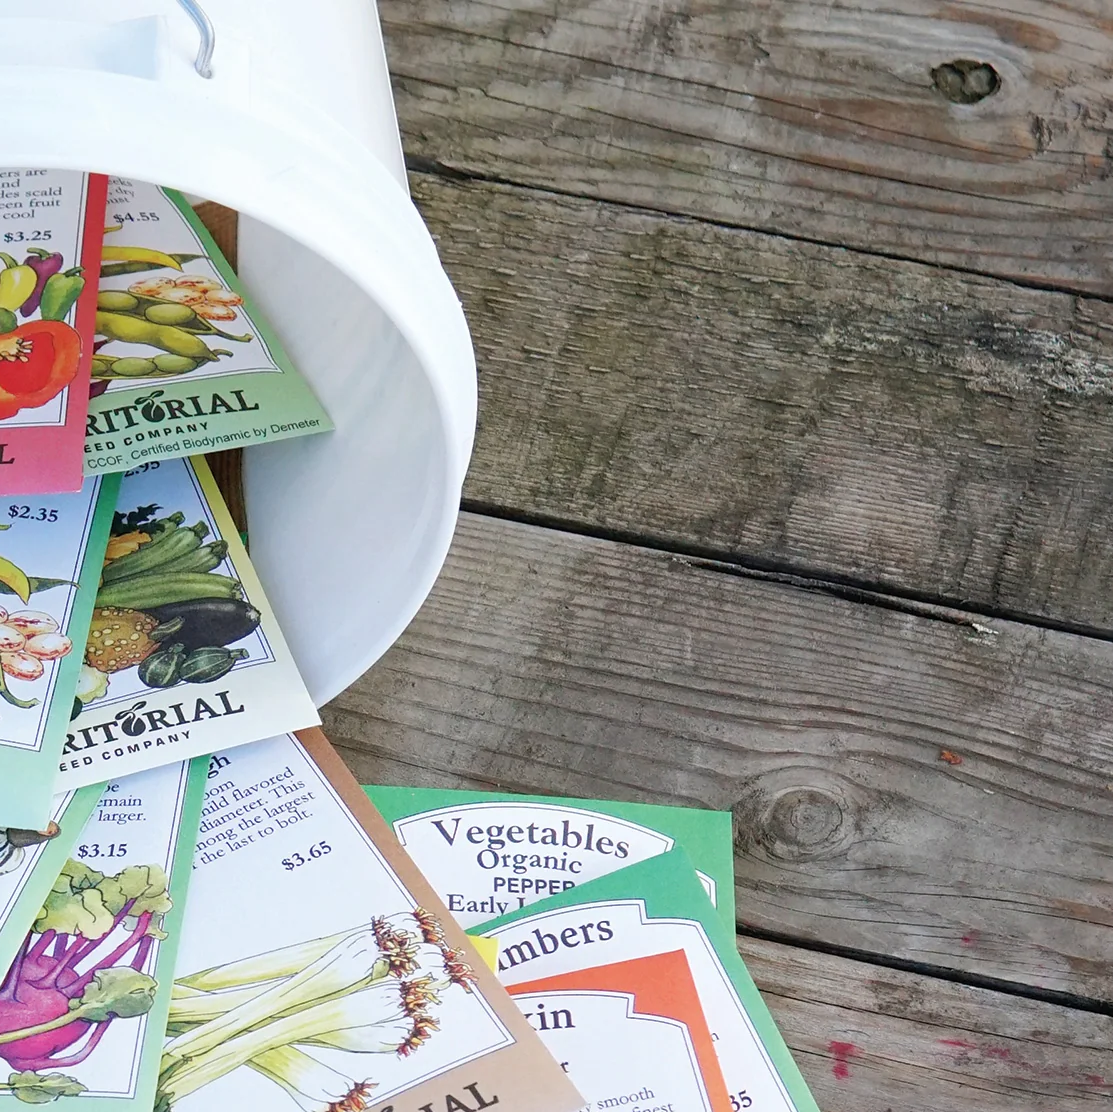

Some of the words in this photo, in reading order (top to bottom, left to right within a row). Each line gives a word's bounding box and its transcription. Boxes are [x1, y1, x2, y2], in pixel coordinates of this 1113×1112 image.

[25, 187, 62, 197] scald
[29, 198, 61, 207] fruit
[113, 212, 159, 223] $4.55
[4, 230, 52, 243] $3.25
[124, 422, 208, 446] COMPANY
[131, 443, 180, 459] Certified
[184, 431, 250, 449] Biodynamic
[270, 419, 321, 434] Demeter
[8, 504, 59, 523] $2.35
[102, 730, 191, 761] COMPANY
[232, 767, 294, 801] flavored
[268, 780, 305, 799] This
[238, 813, 263, 831] the
[267, 792, 315, 820] largest
[200, 849, 226, 865] the
[228, 835, 254, 852] last
[432, 817, 629, 859] Vegetables
[77, 843, 128, 859] $3.15
[281, 841, 332, 871] $3.65
[477, 849, 583, 874] Organic
[448, 893, 508, 918] Early
[597, 1087, 655, 1109] smooth
